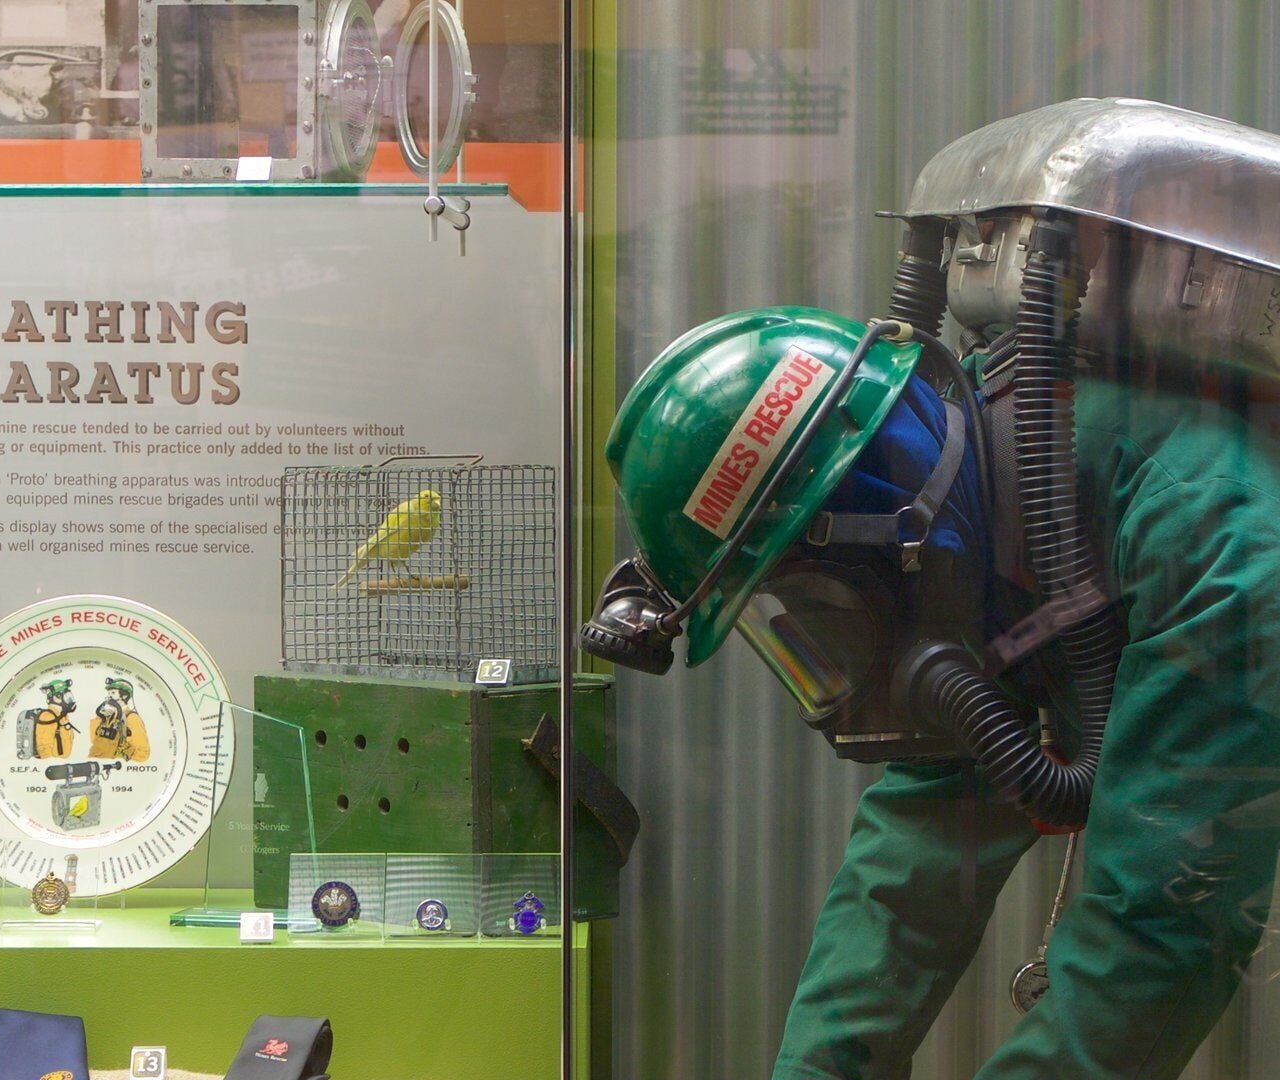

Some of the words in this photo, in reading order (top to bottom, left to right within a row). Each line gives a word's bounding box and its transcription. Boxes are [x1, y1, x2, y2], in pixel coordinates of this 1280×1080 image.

[33, 424, 76, 434] rescue
[83, 422, 128, 434] tended
[135, 422, 148, 434] to
[154, 422, 170, 434] be
[175, 422, 222, 435] carried
[228, 423, 250, 435] out
[256, 423, 271, 438] by
[277, 423, 347, 436] volunteers
[353, 424, 404, 436] without
[692, 443, 760, 530] MINES
[743, 353, 823, 447] RESCUE
[8, 539, 34, 551] well
[40, 539, 103, 555] organised
[110, 540, 149, 552] mines
[156, 543, 198, 553] rescue
[204, 541, 253, 553] service.
[11, 615, 63, 646] MINES
[71, 611, 142, 633] RESCUE
[147, 628, 206, 686] SERVICE
[481, 664, 503, 679] 12
[259, 821, 290, 831] Service
[137, 1056, 159, 1072] 13
